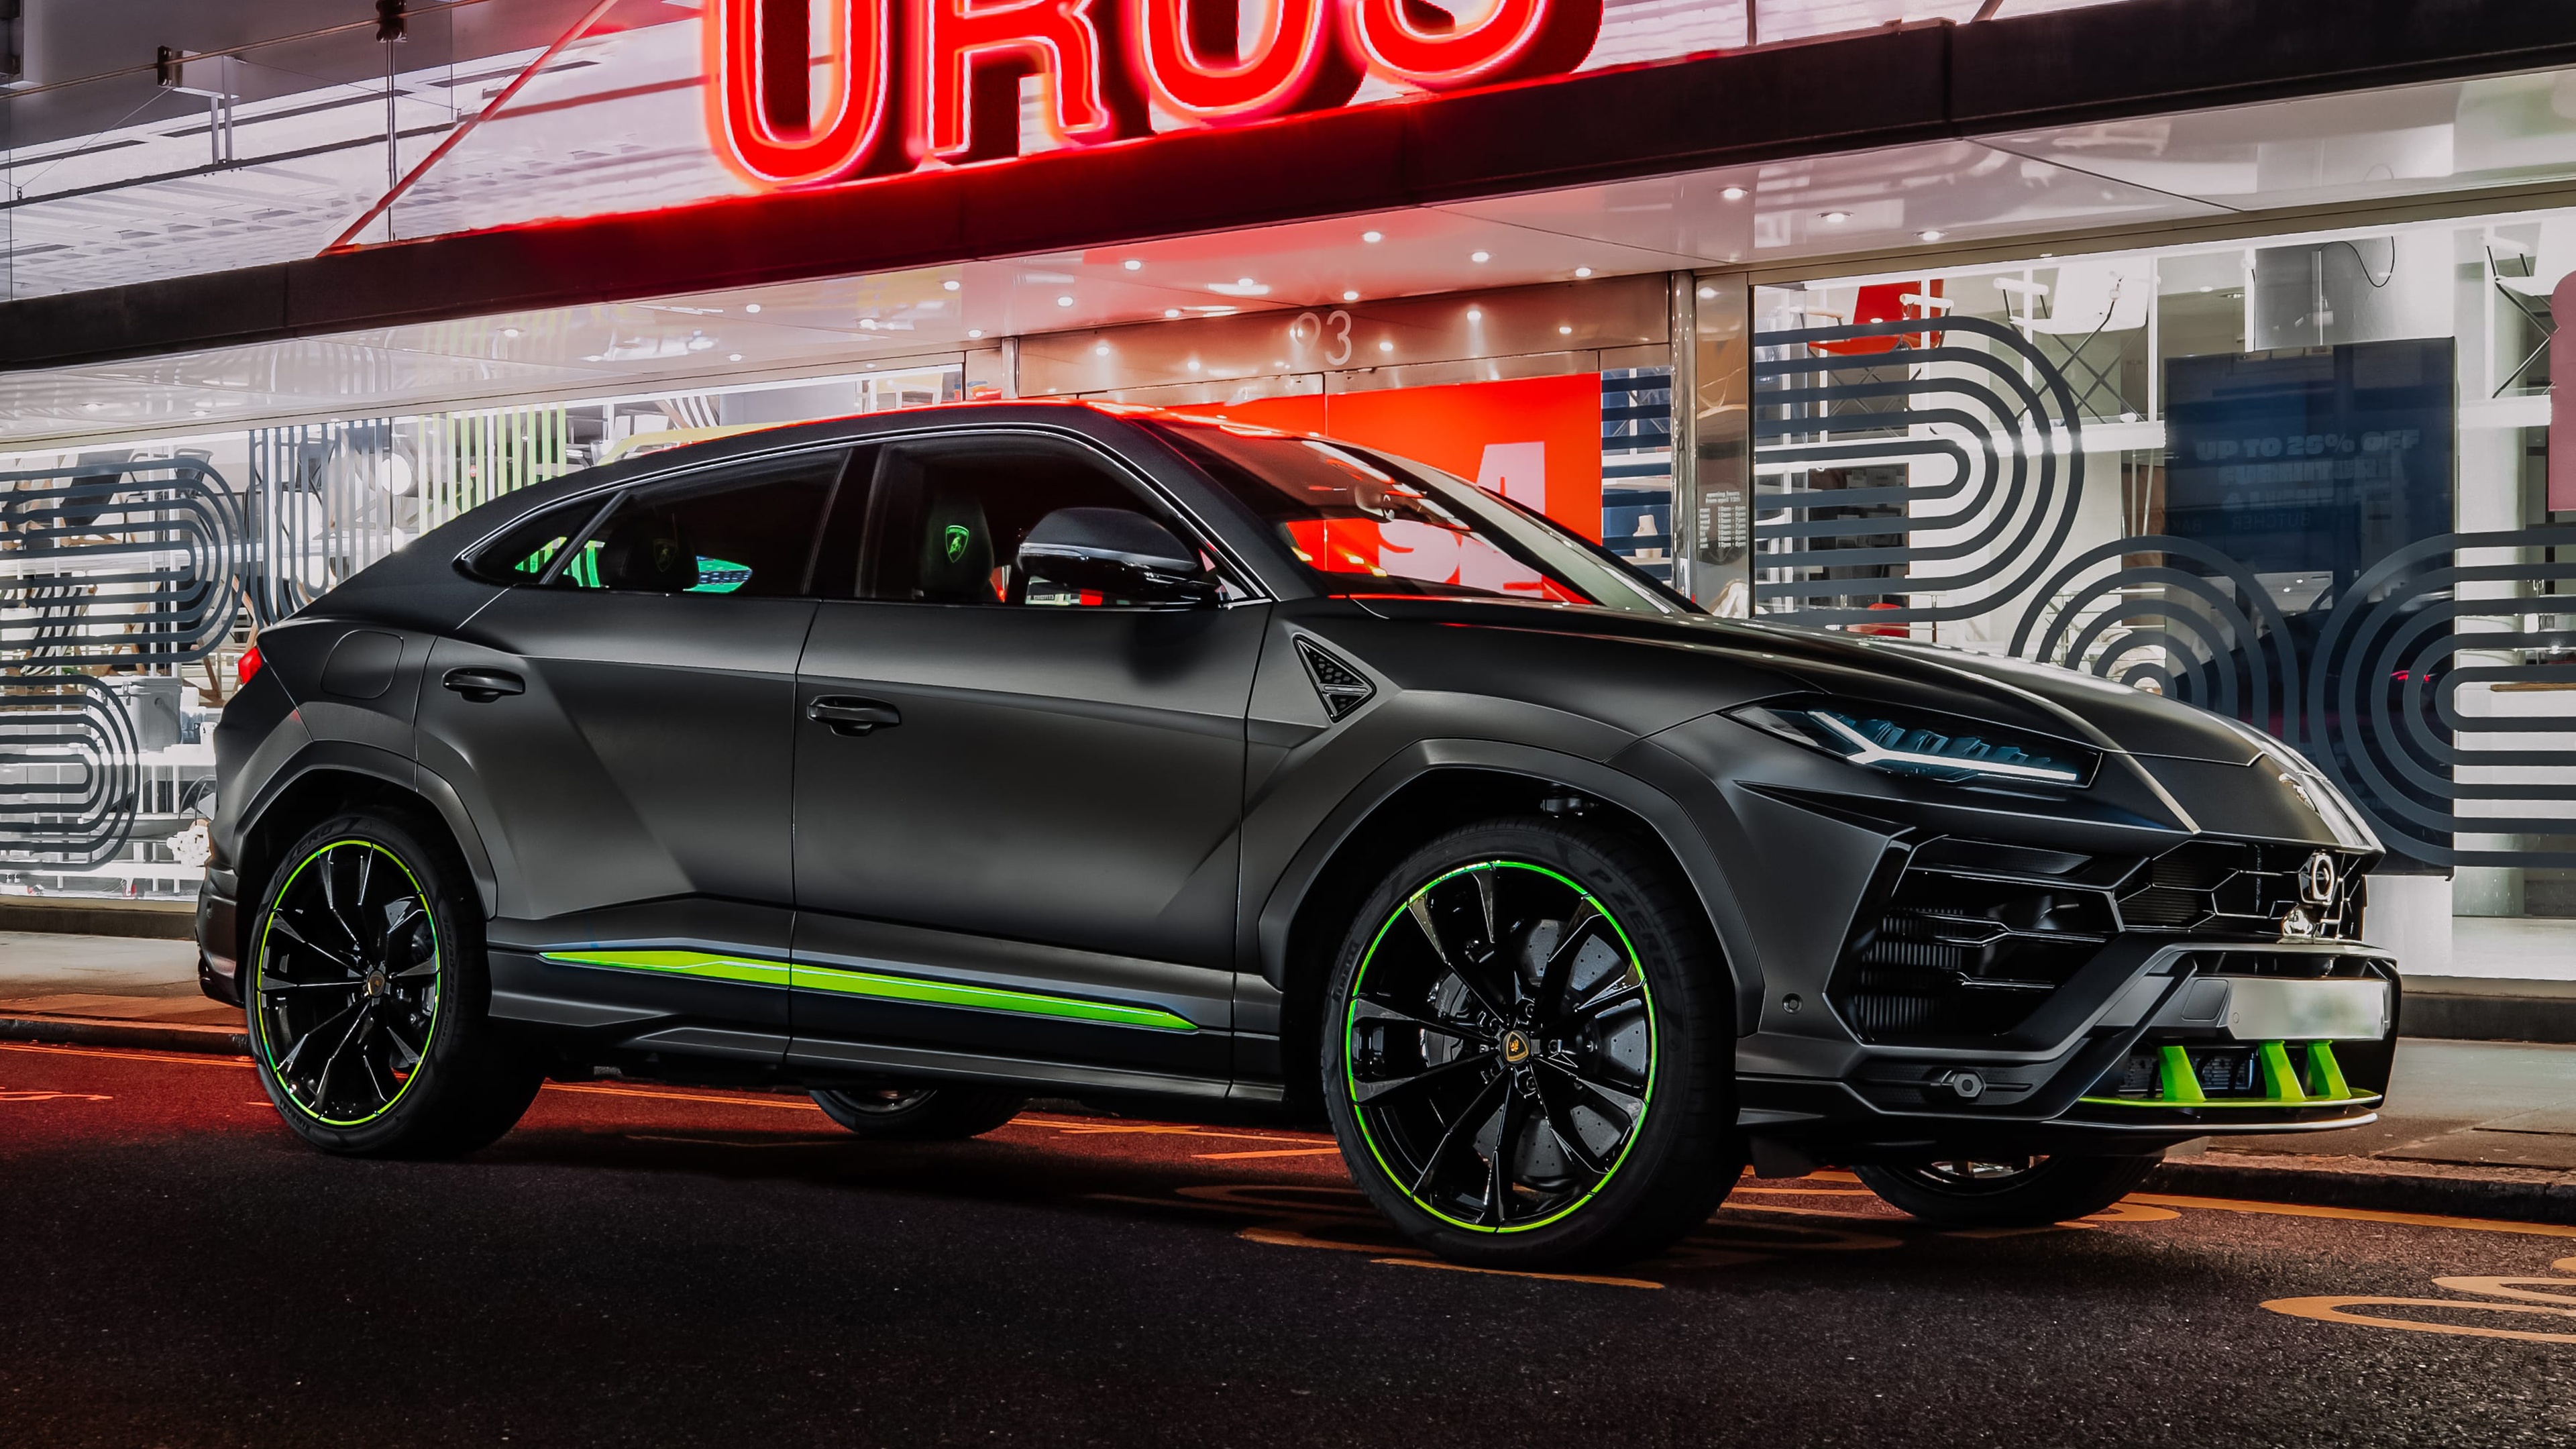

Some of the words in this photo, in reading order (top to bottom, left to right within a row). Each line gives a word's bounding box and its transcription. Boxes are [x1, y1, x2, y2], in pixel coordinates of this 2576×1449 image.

[712, 0, 1543, 181] UR
[2196, 440, 2239, 460] UP
[2243, 437, 2282, 458] TO
[2287, 433, 2355, 455] 25%
[2361, 429, 2420, 452] OFF
[1610, 889, 1674, 981] ZERO
